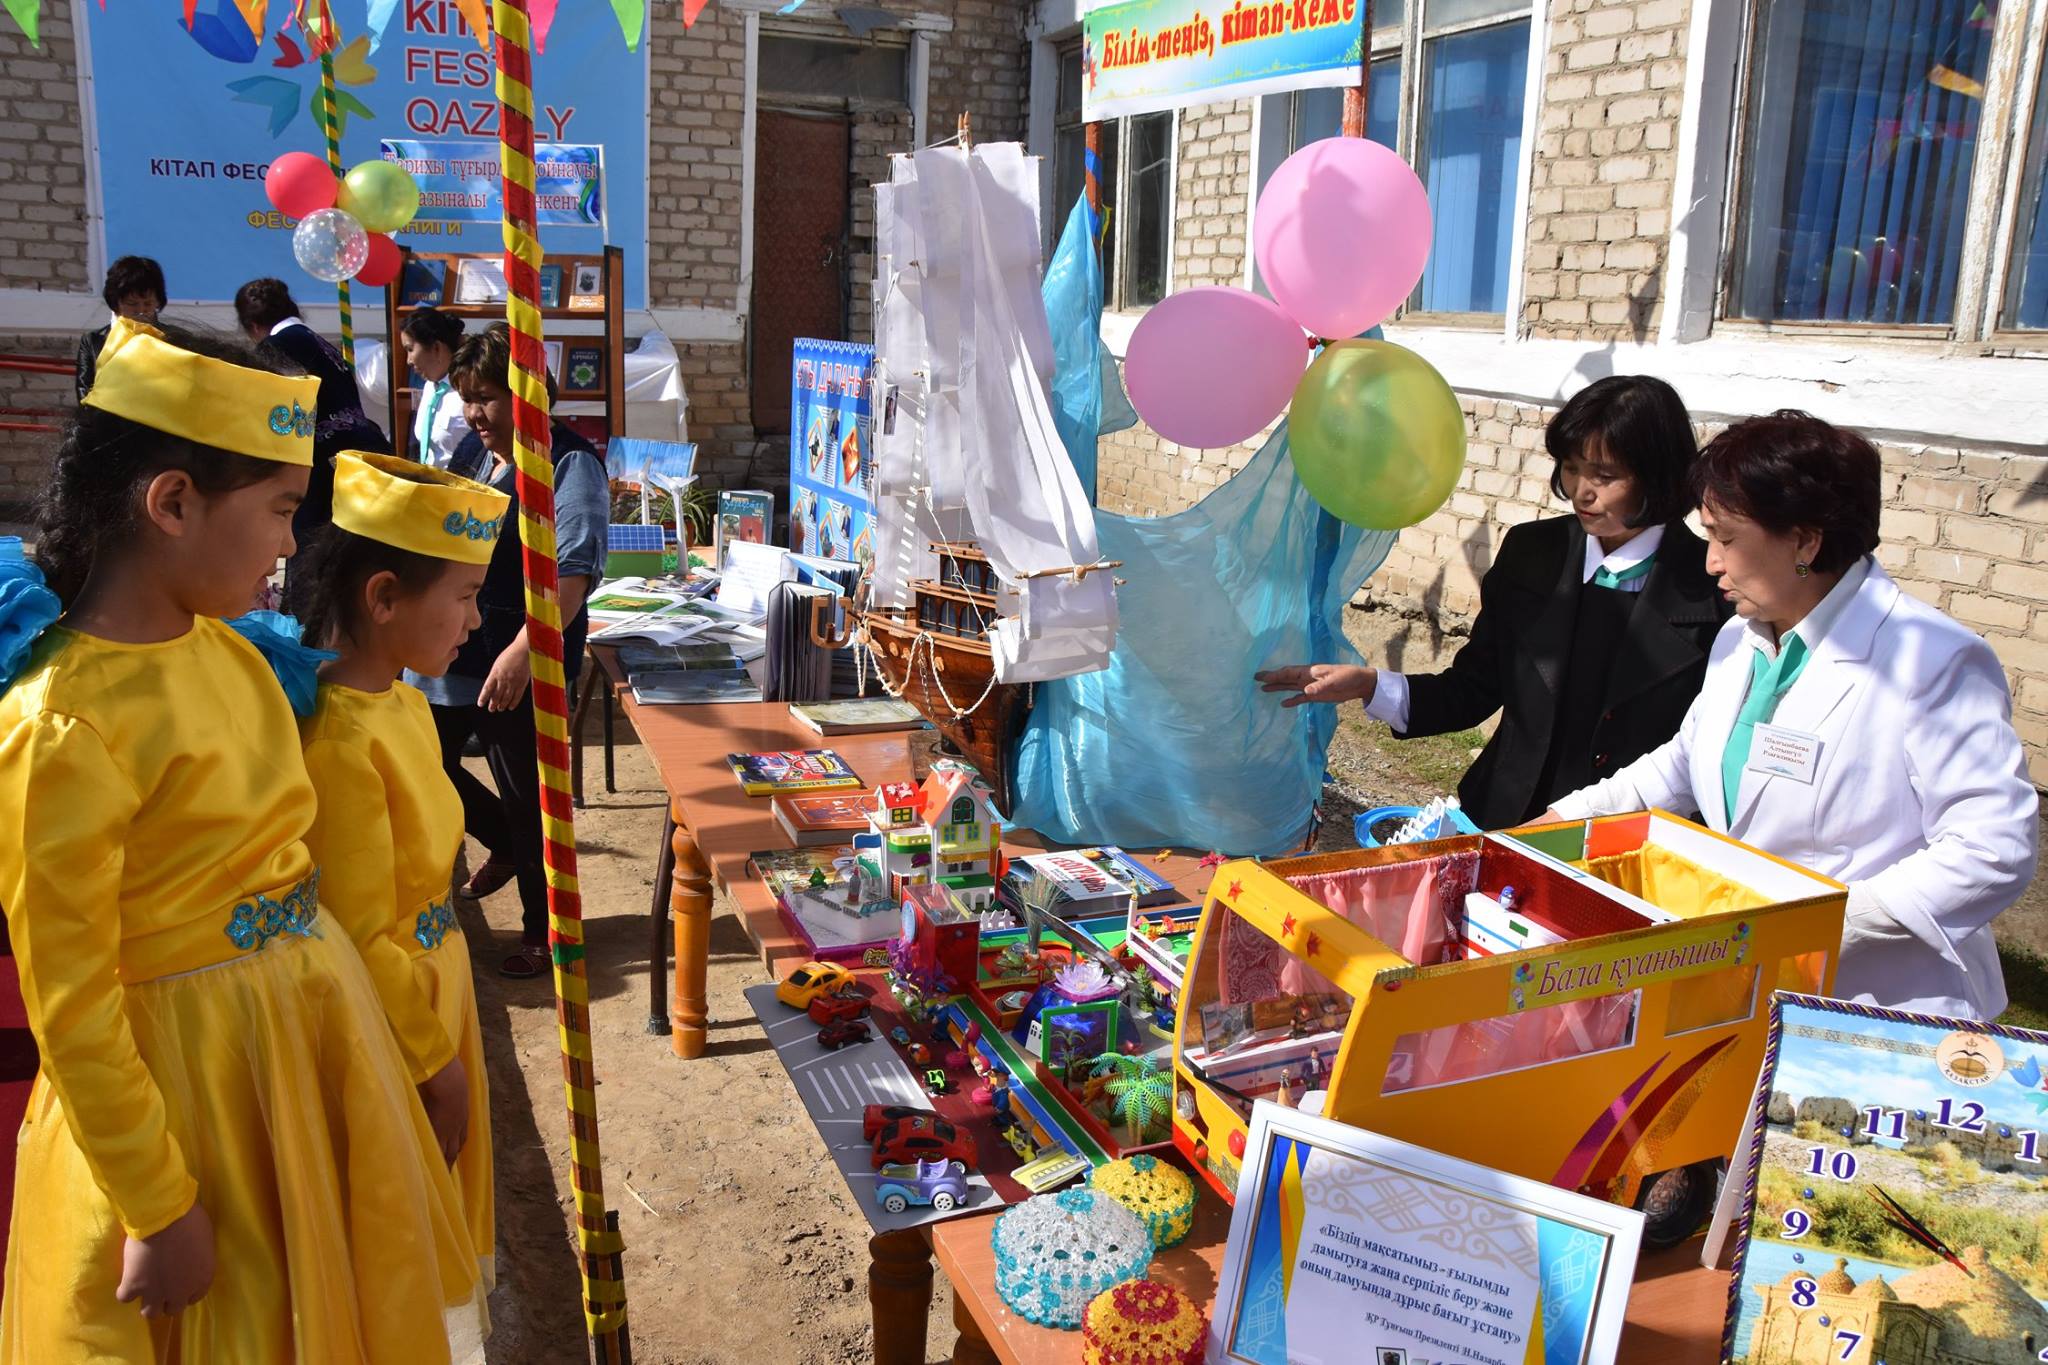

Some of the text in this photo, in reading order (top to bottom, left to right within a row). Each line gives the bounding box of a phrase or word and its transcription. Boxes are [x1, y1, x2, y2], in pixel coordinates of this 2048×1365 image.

[1102, 0, 1354, 68] Білім-теңіз, кітап-кеме
[406, 48, 497, 87] FES
[406, 98, 575, 141] QAZY
[151, 158, 215, 179] КІТАП
[535, 159, 598, 183] ойнауы
[418, 192, 487, 208] азыналы
[1537, 938, 1729, 996] Бала қуанышы
[1862, 1107, 1908, 1141] 11
[1932, 1099, 1986, 1132] 12
[2015, 1131, 2042, 1163] 1
[1805, 1147, 1857, 1181] 10
[1781, 1210, 1810, 1238] 9
[1320, 1223, 1361, 1249] «Біздің
[1362, 1240, 1438, 1273] мақсатымыз
[1447, 1268, 1511, 1297] ғылымды
[1311, 1243, 1513, 1319] дамытуға жаңа серпіліс беру және
[1790, 1279, 1819, 1308] 8
[1300, 1259, 1521, 1344] оның дамуында дұрыс бағыт ұстану»
[1414, 1329, 1461, 1353] Президенті
[1834, 1330, 1862, 1361] 7
